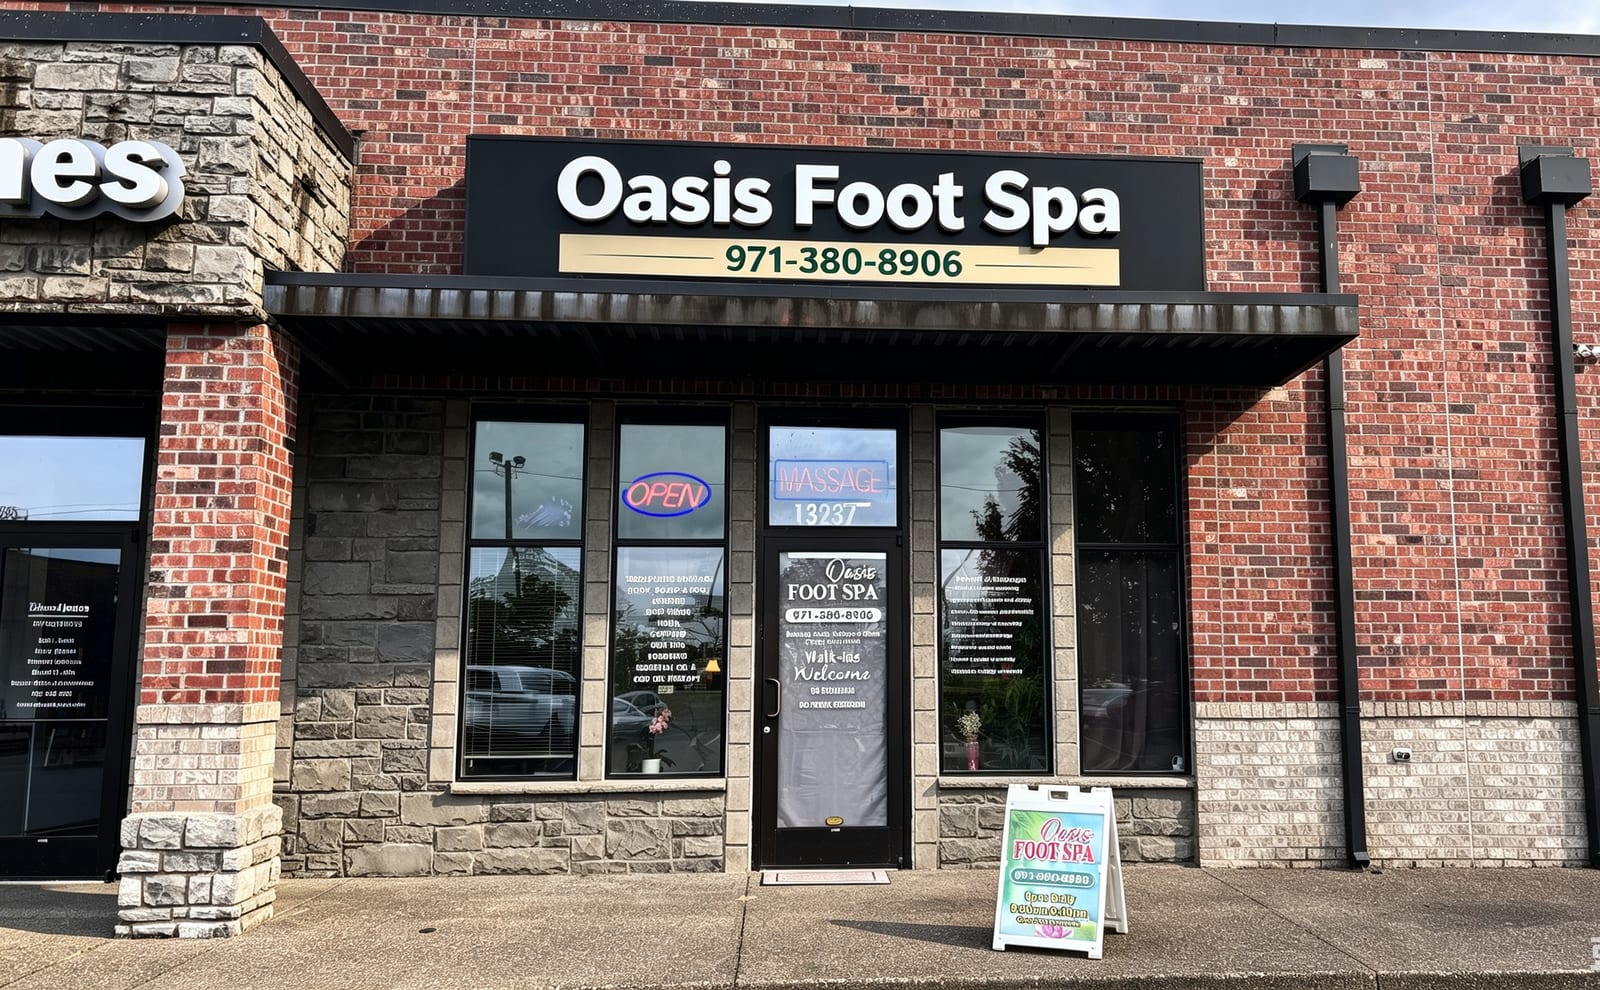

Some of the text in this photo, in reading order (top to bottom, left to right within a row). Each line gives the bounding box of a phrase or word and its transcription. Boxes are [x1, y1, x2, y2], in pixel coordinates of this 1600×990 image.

[557, 156, 1121, 247] Oasis Foot Spa
[725, 244, 963, 277] 971-380-8906
[779, 466, 883, 494] MASSAGE
[626, 481, 704, 509] OPEN
[788, 584, 878, 600] FOOT SPA
[794, 664, 871, 680] Welcome
[1014, 840, 1094, 863] FOOT SPA
